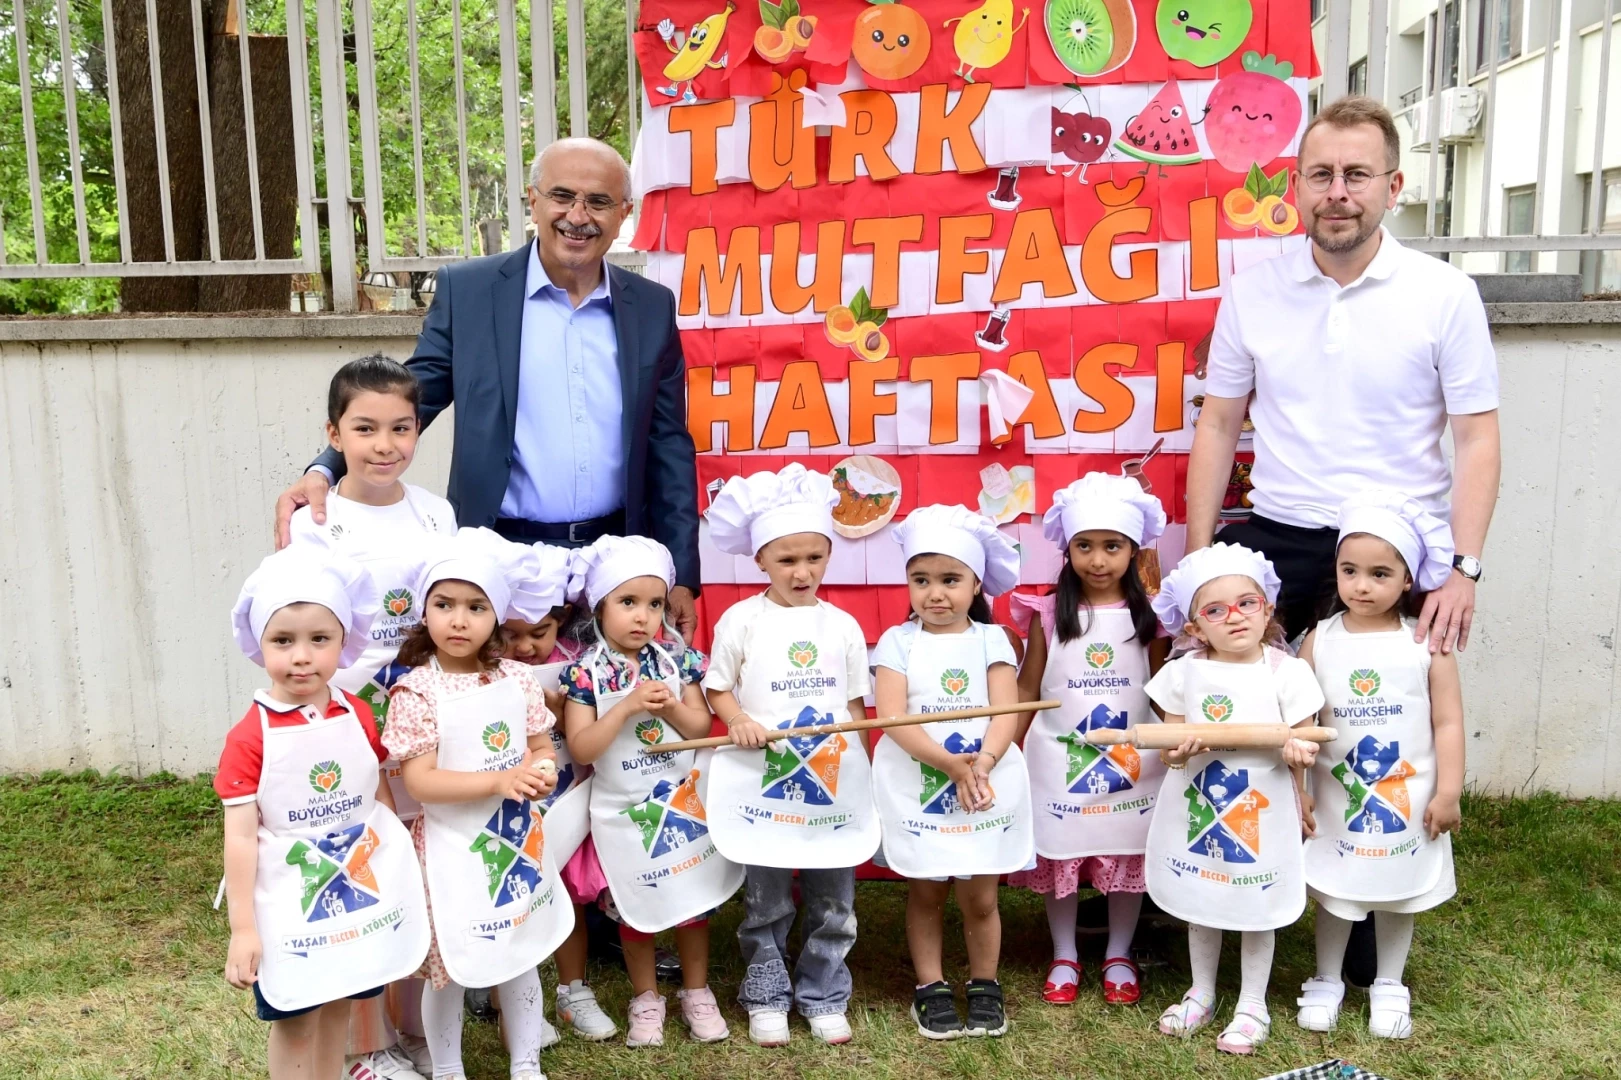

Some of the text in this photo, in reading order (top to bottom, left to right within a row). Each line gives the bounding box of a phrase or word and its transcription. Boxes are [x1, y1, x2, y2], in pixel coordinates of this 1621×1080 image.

[668, 68, 993, 196] TÜRK
[677, 176, 1221, 318] MUTFAĞI
[686, 342, 1188, 453] HAFTASI
[381, 615, 417, 627] MALATYA
[786, 668, 823, 678] MALATYA
[1083, 669, 1117, 677] MALATYA
[937, 696, 972, 704] MALATYA
[1348, 696, 1385, 706] MALATYA
[484, 747, 518, 766] MALATYA
[308, 789, 348, 806] MALATYA
[1052, 796, 1149, 815] YAŞAM BECERİ ATÖLYESİ
[744, 805, 847, 827] YAŞAM BECERİ ATÖLYESİ
[907, 814, 1011, 834] YAŞAM BECERİ ATÖLYESİ
[1355, 846, 1389, 857] BECERİ
[1390, 835, 1417, 857] ATÖLYESİ
[642, 868, 671, 882] YAŞAM
[671, 853, 702, 876] BECERİ
[1171, 857, 1274, 886] YAŞAM BECERİ ATÖLYESİ
[291, 907, 402, 950] YAŞAM BECERİ ATÖLYESİ
[479, 919, 511, 934] YAŞAM
